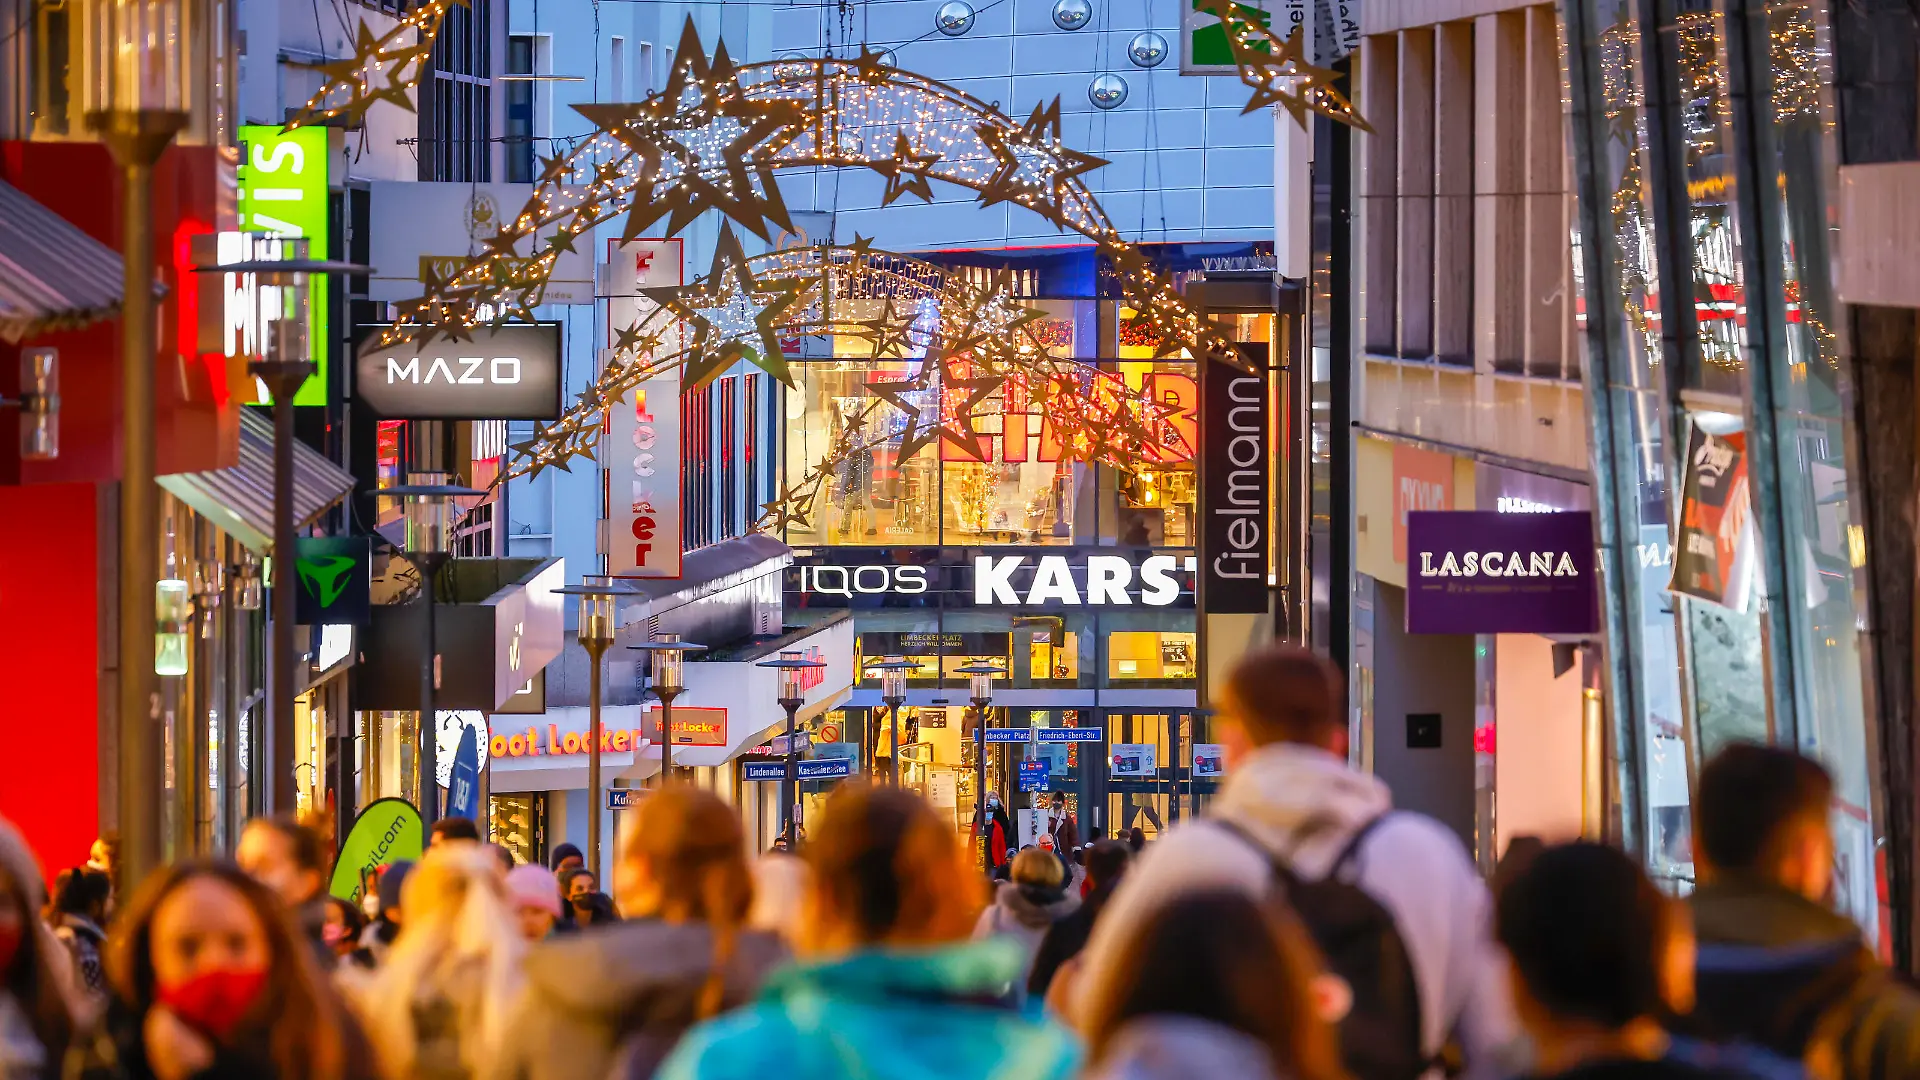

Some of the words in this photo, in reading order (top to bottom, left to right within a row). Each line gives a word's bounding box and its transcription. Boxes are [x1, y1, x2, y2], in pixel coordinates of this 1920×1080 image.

[387, 357, 521, 384] MAZO
[1213, 377, 1260, 579] fielmann
[1420, 551, 1579, 577] LASCANA
[801, 565, 928, 599] IQOS
[682, 721, 720, 733] Locker
[1039, 731, 1097, 740] Friedrich-Ebert-Str.
[488, 726, 539, 757] oot
[750, 767, 785, 777] Lindenallee
